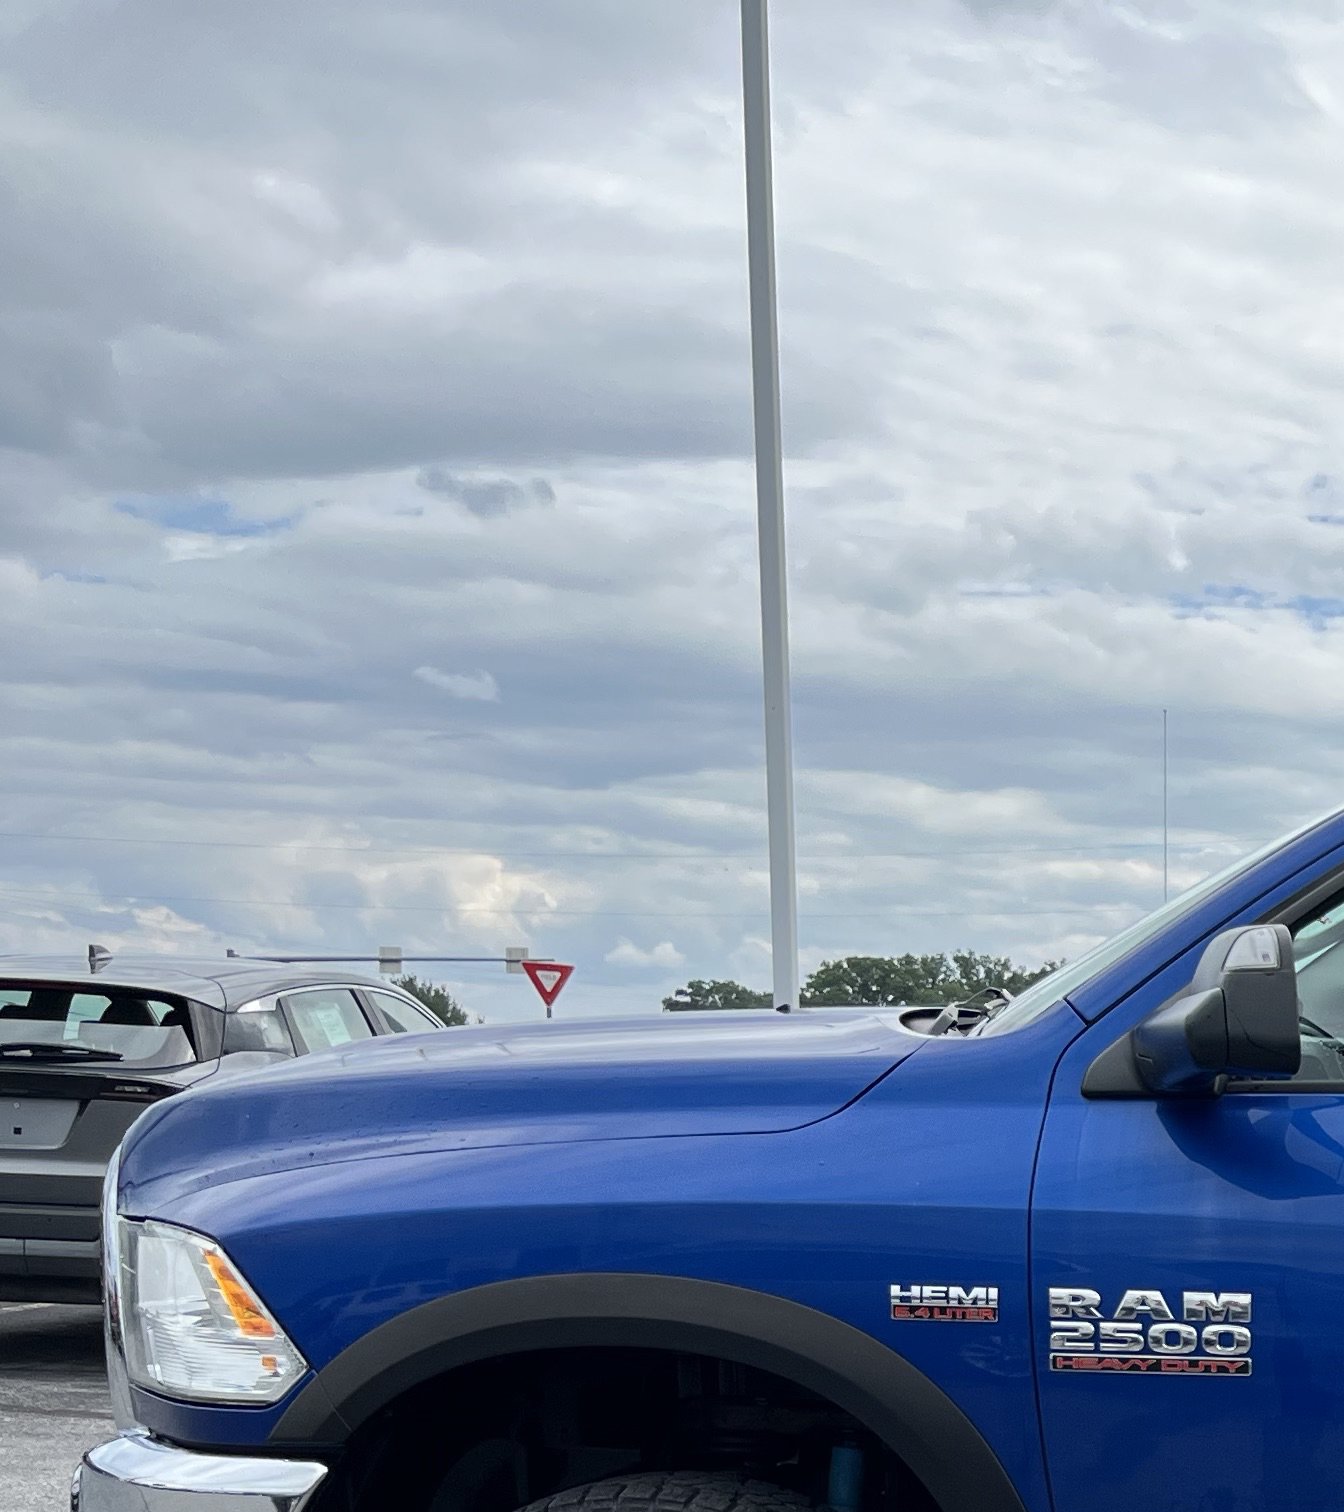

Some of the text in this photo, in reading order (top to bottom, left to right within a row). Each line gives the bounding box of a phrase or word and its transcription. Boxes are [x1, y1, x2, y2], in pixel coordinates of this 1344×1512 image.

[890, 1284, 999, 1307] HEMI
[1049, 1287, 1252, 1323] RAM
[933, 1307, 994, 1321] LITER
[1049, 1321, 1252, 1355] 2500
[1056, 1356, 1245, 1373] HEAVY DUTY
